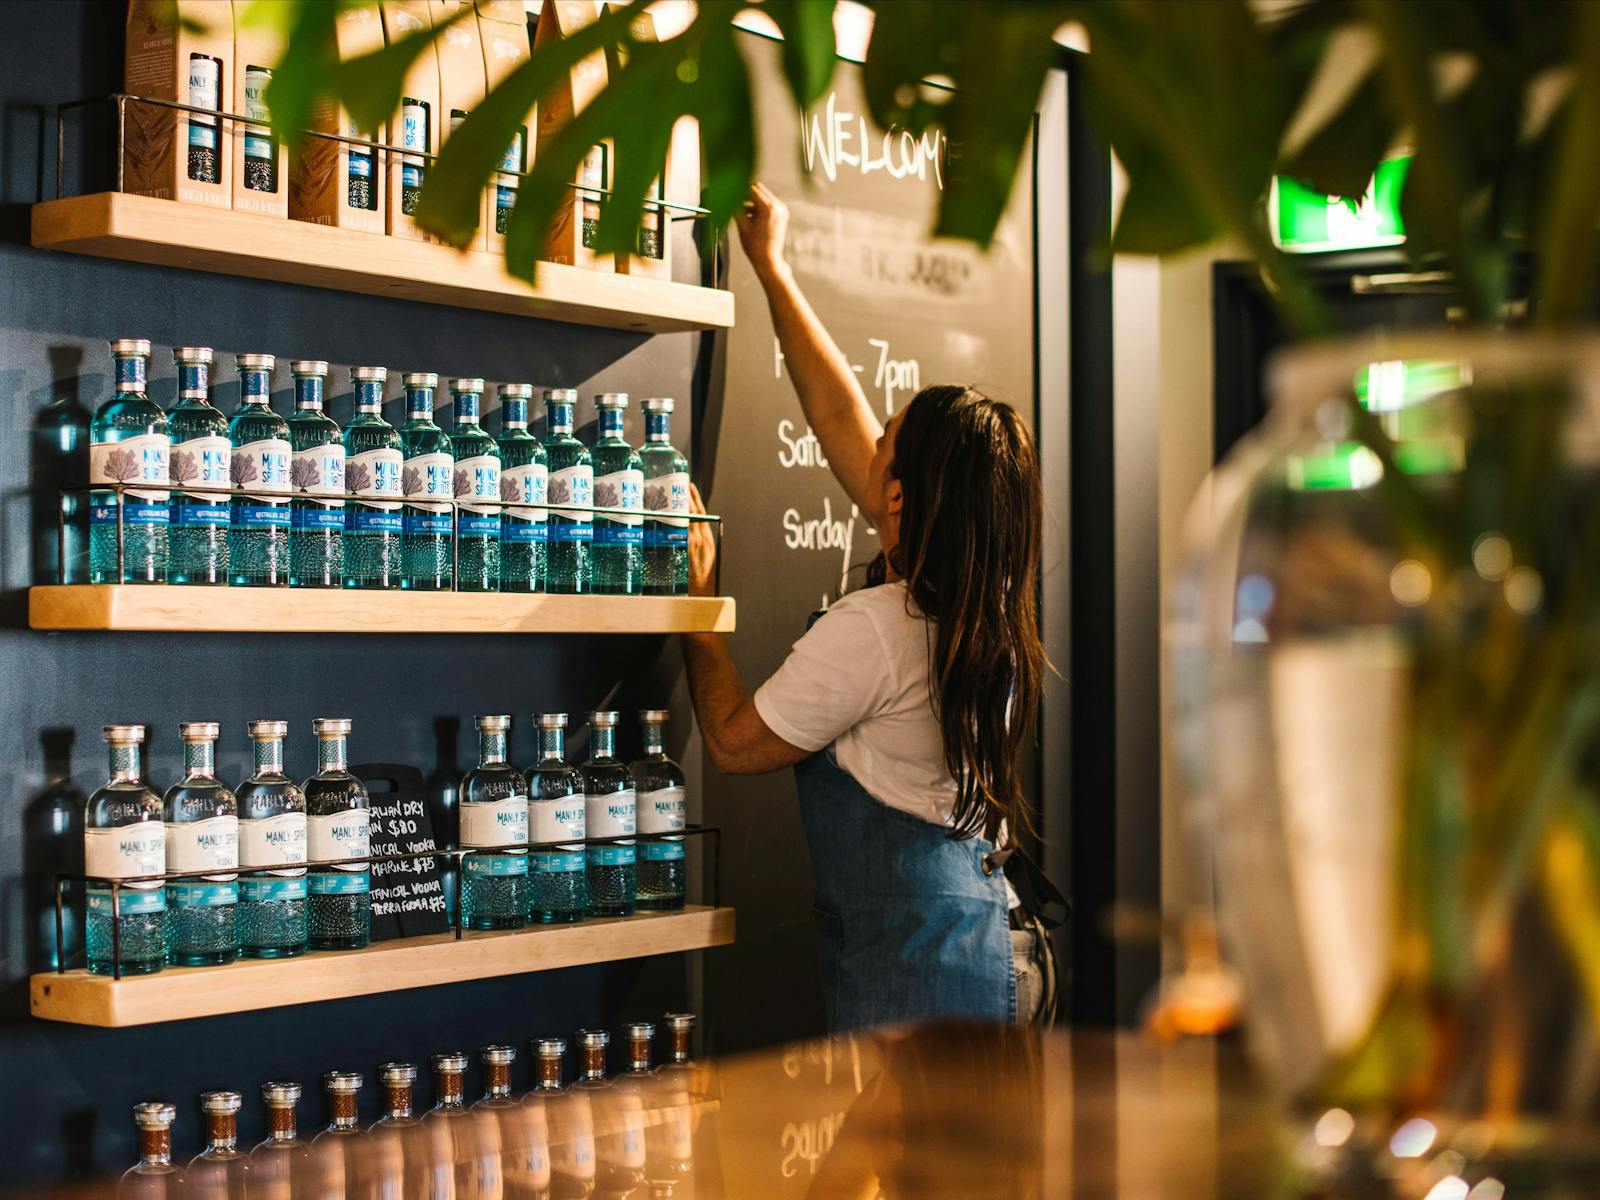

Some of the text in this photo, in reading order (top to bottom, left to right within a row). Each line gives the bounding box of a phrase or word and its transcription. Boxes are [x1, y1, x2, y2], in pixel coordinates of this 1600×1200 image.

[801, 92, 965, 191] WELCOM
[868, 338, 920, 416] 7pm
[783, 497, 859, 595] Sunday
[403, 801, 424, 818] DRY
[555, 810, 577, 824] MANLY
[608, 805, 628, 818] MANLY
[497, 812, 519, 826] MANLY
[331, 826, 355, 841] MANLY
[369, 820, 417, 838] IN $80
[197, 834, 222, 849] MANLY
[266, 831, 290, 846] MANLY
[121, 841, 146, 856] MANLY
[350, 847, 365, 857] VODKA
[369, 838, 436, 857] NICAL VODKA
[371, 857, 435, 877] MARINE $75
[411, 880, 441, 895] VODKA
[428, 895, 446, 913] $75
